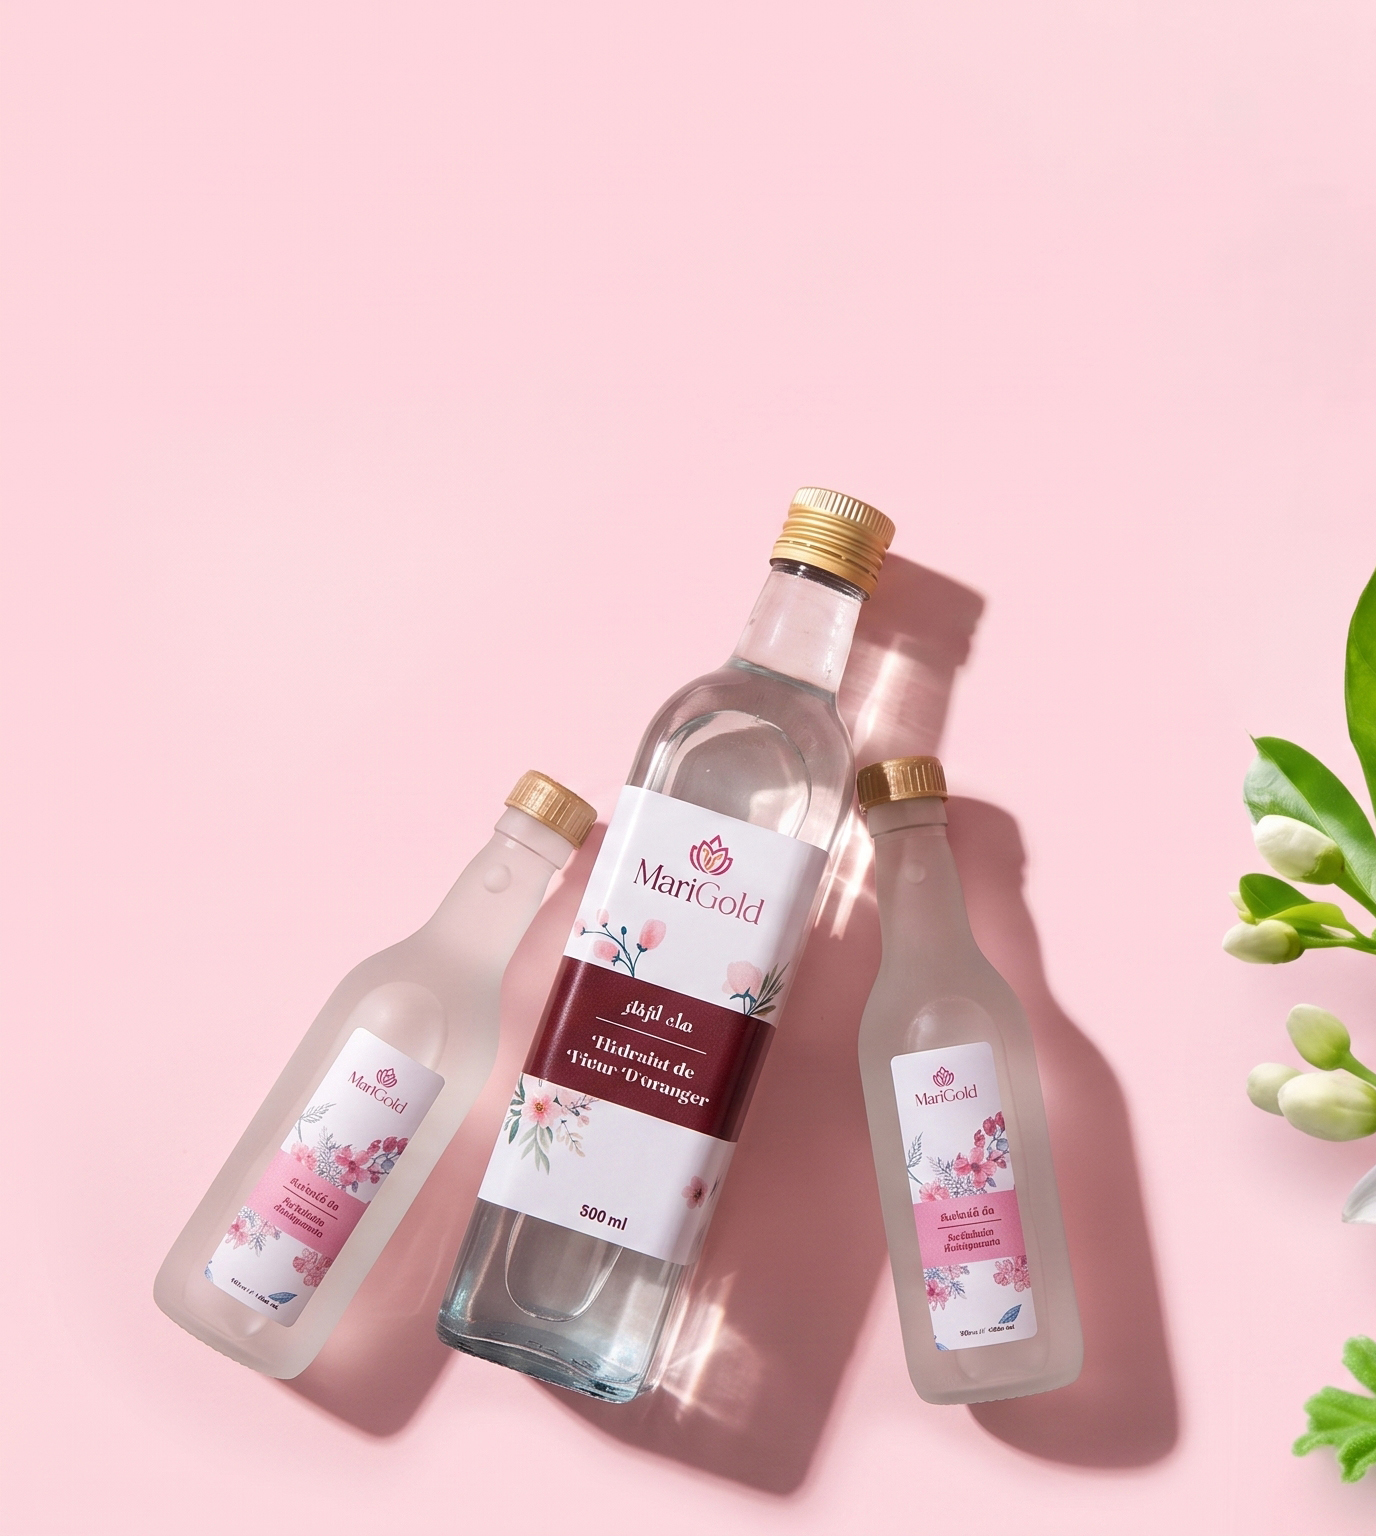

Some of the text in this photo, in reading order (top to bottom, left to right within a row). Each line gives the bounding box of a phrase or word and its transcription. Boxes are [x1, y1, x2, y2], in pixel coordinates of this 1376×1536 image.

[633, 858, 765, 925] MariGold
[672, 1062, 695, 1079] de
[915, 1084, 978, 1106] MariGold
[579, 1204, 628, 1231] 500 ml
